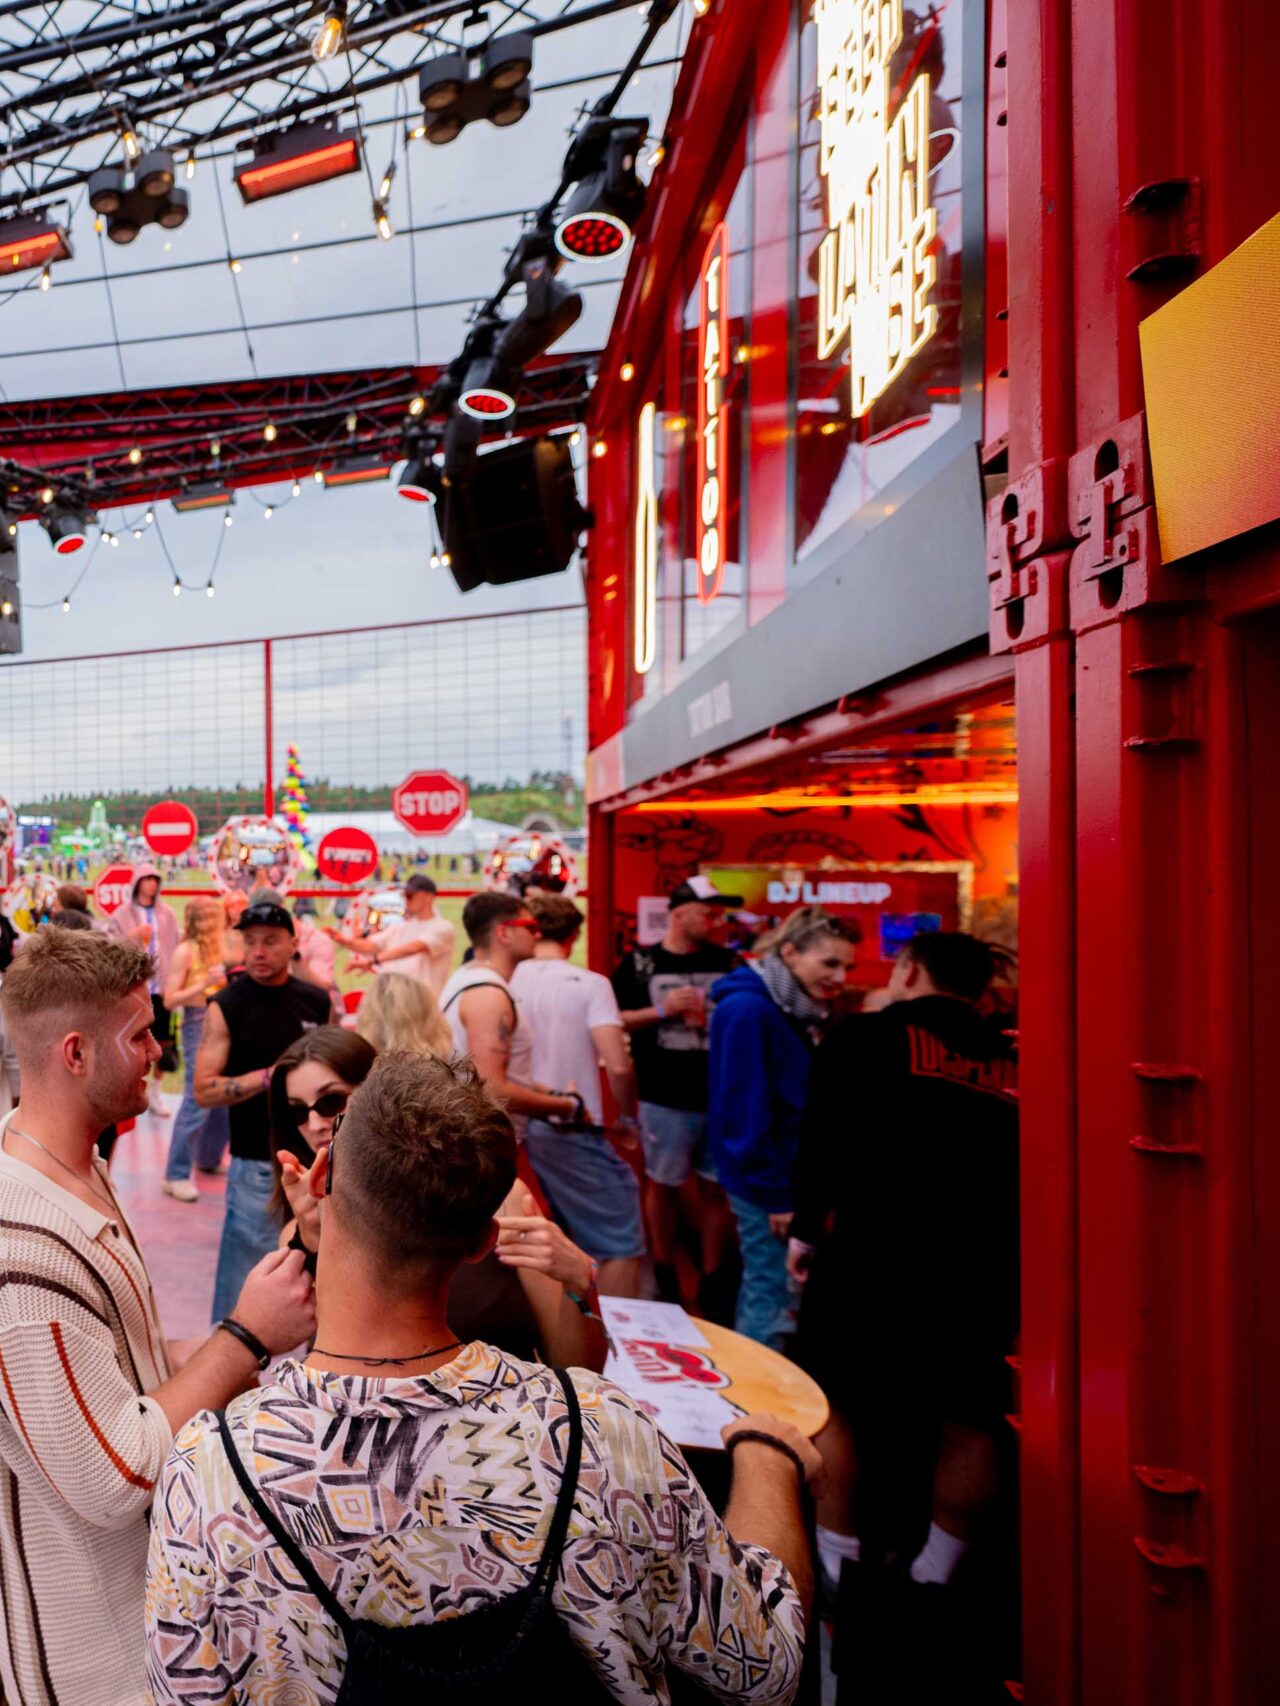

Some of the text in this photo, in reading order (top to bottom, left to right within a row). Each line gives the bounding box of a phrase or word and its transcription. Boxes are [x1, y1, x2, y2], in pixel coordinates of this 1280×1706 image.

[702, 255, 722, 577] TATTOO
[400, 790, 460, 816] STOP
[100, 883, 132, 906] STO
[767, 880, 892, 904] DJ LINEUP
